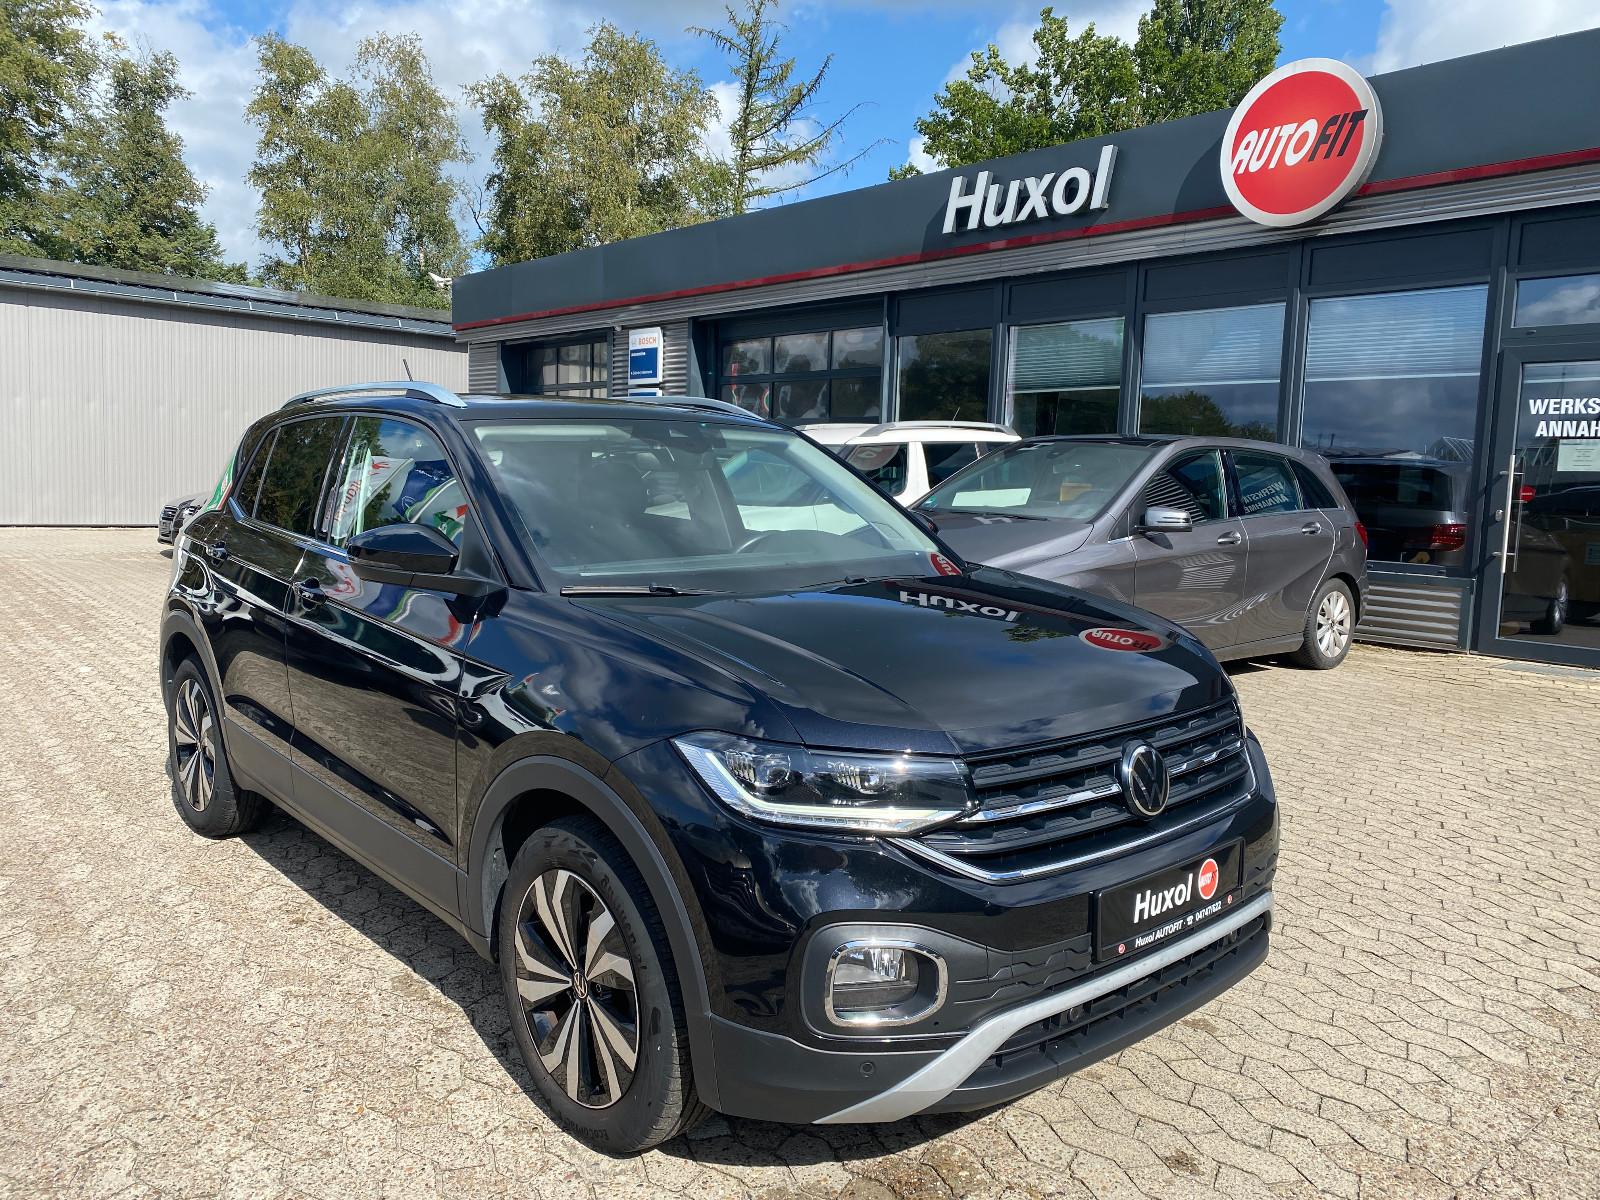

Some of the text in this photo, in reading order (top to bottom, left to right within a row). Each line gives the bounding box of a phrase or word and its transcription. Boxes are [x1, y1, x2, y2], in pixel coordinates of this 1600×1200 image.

[1232, 108, 1369, 175] AUTOFIT
[942, 144, 1118, 235] Huxol
[638, 336, 657, 346] BOSCH
[1529, 397, 1600, 415] WERKS
[1134, 873, 1193, 923] Huxol
[1135, 933, 1155, 948] Huxol
[1154, 921, 1183, 939] AUTOFIT
